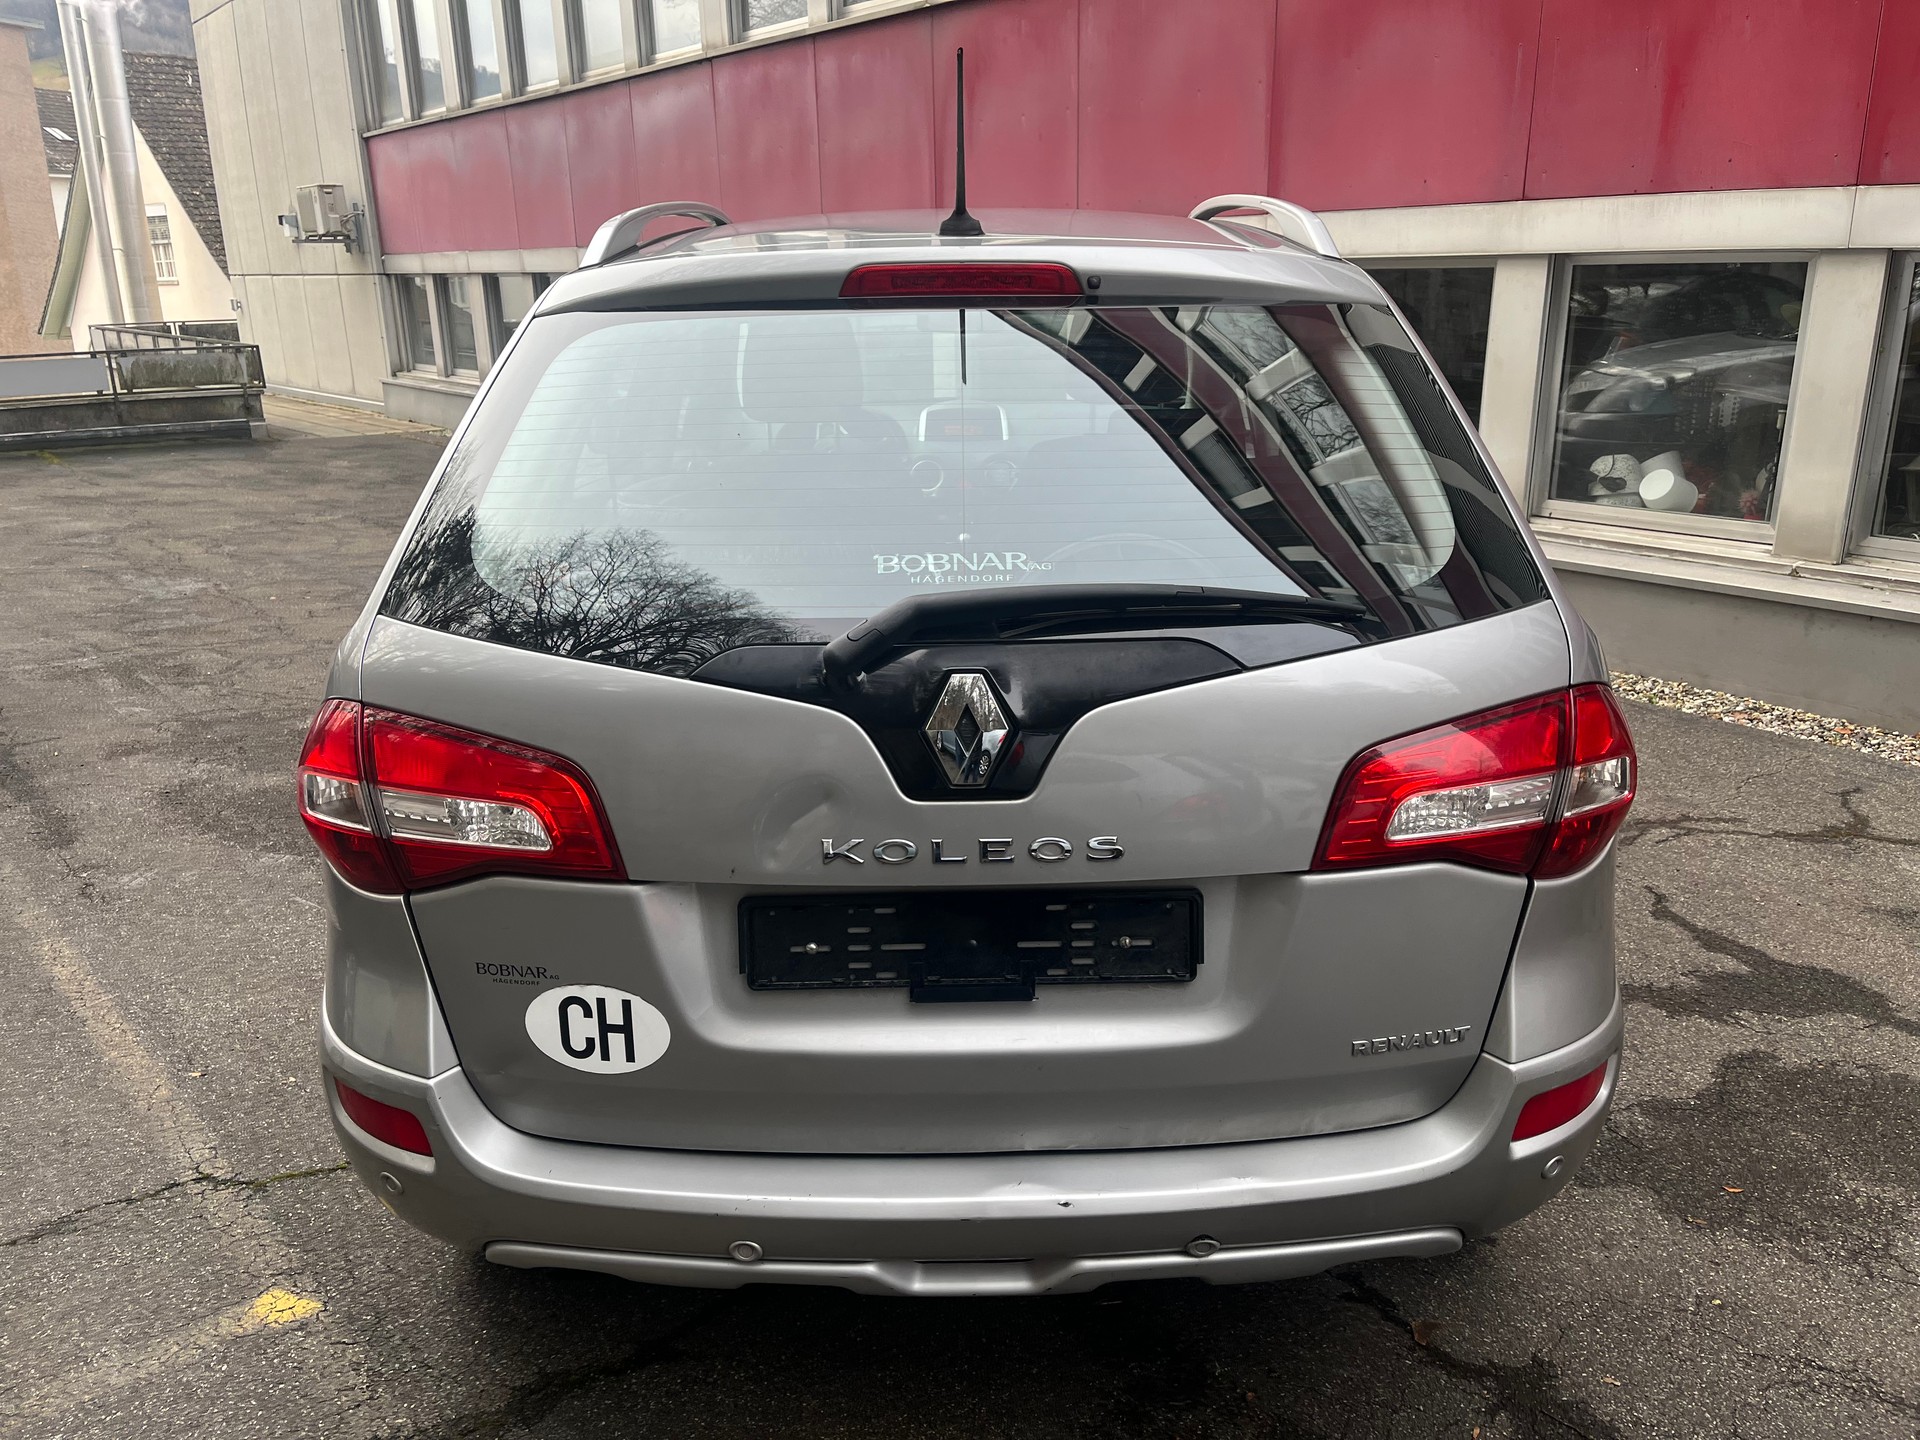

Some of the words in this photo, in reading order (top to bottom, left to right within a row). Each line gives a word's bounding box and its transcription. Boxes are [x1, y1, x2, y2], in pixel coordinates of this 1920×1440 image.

[873, 552, 1028, 575] BOBNAR
[1031, 562, 1053, 571] AG
[821, 836, 1125, 864] KOLEOS
[475, 962, 548, 979] BOBNAR
[558, 995, 636, 1063] CH
[1351, 1025, 1472, 1056] RENAULT
